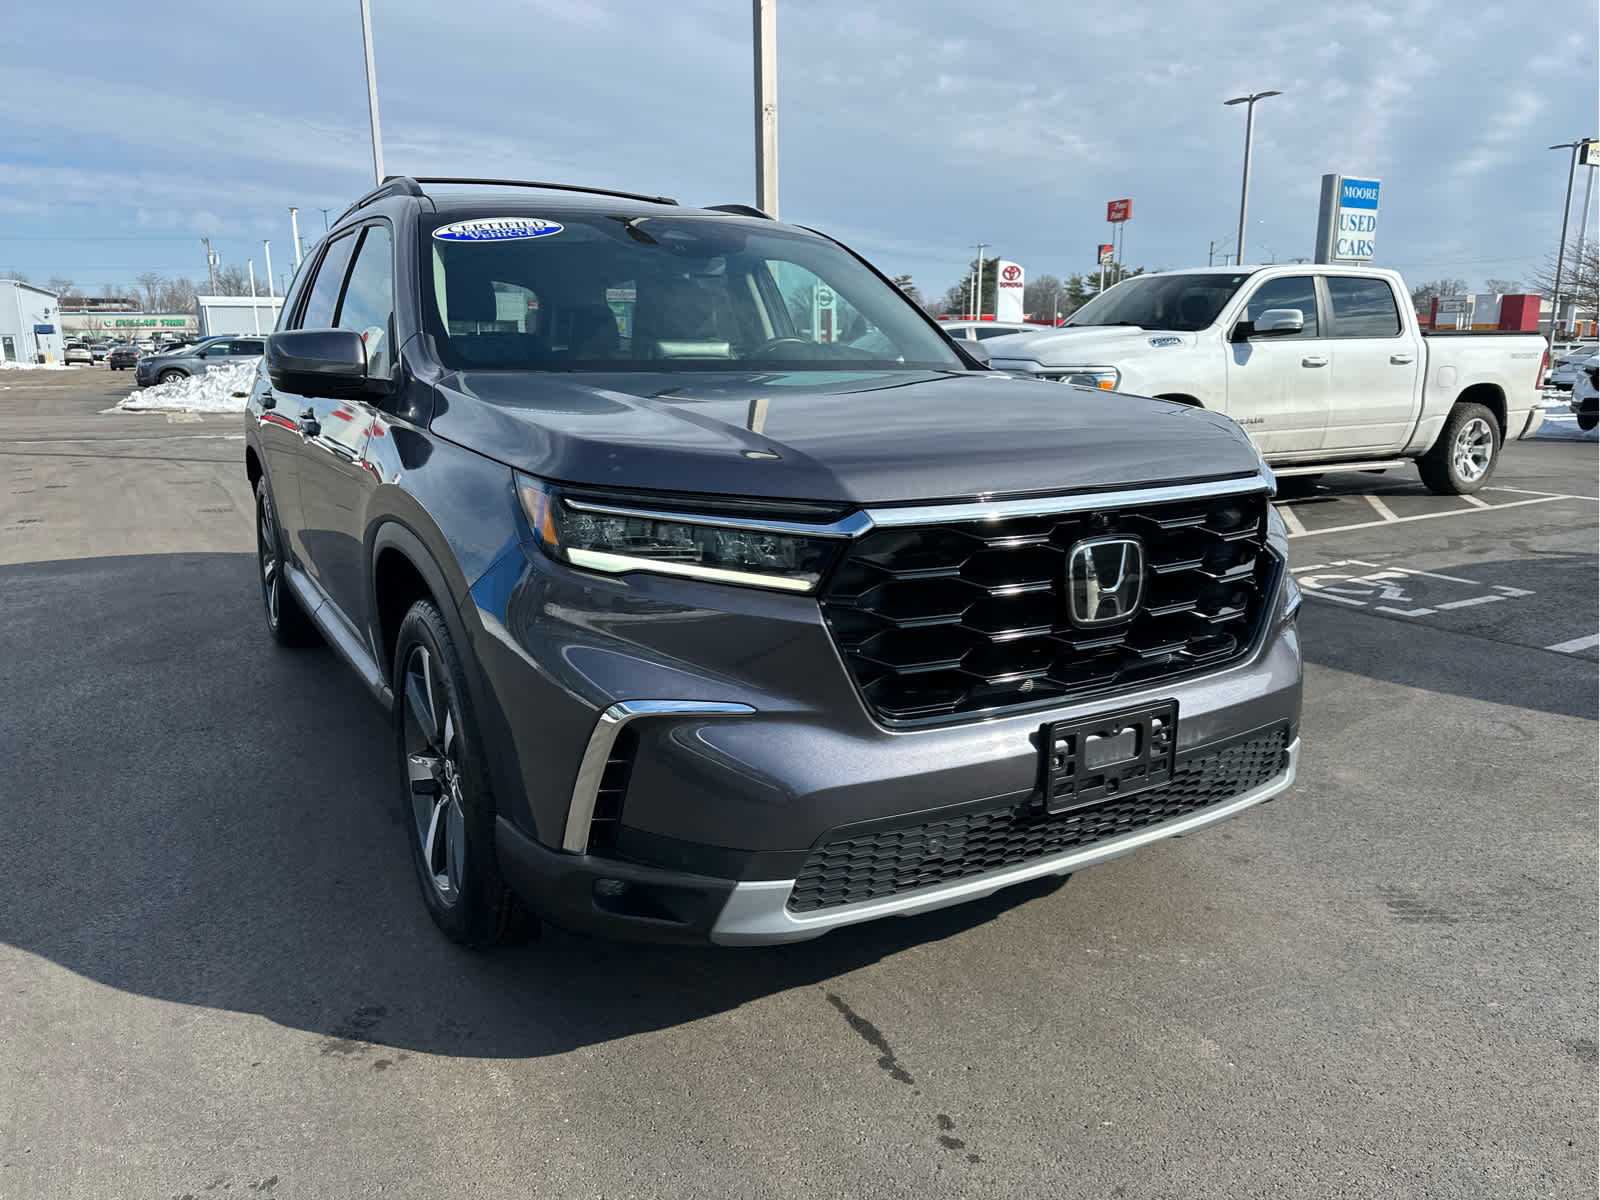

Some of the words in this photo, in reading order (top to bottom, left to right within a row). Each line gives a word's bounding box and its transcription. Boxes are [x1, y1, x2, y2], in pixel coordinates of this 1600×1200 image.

[1343, 186, 1378, 200] MOORE
[447, 220, 547, 233] CERTIFIED
[1340, 213, 1376, 232] USED
[1336, 238, 1374, 256] CARS
